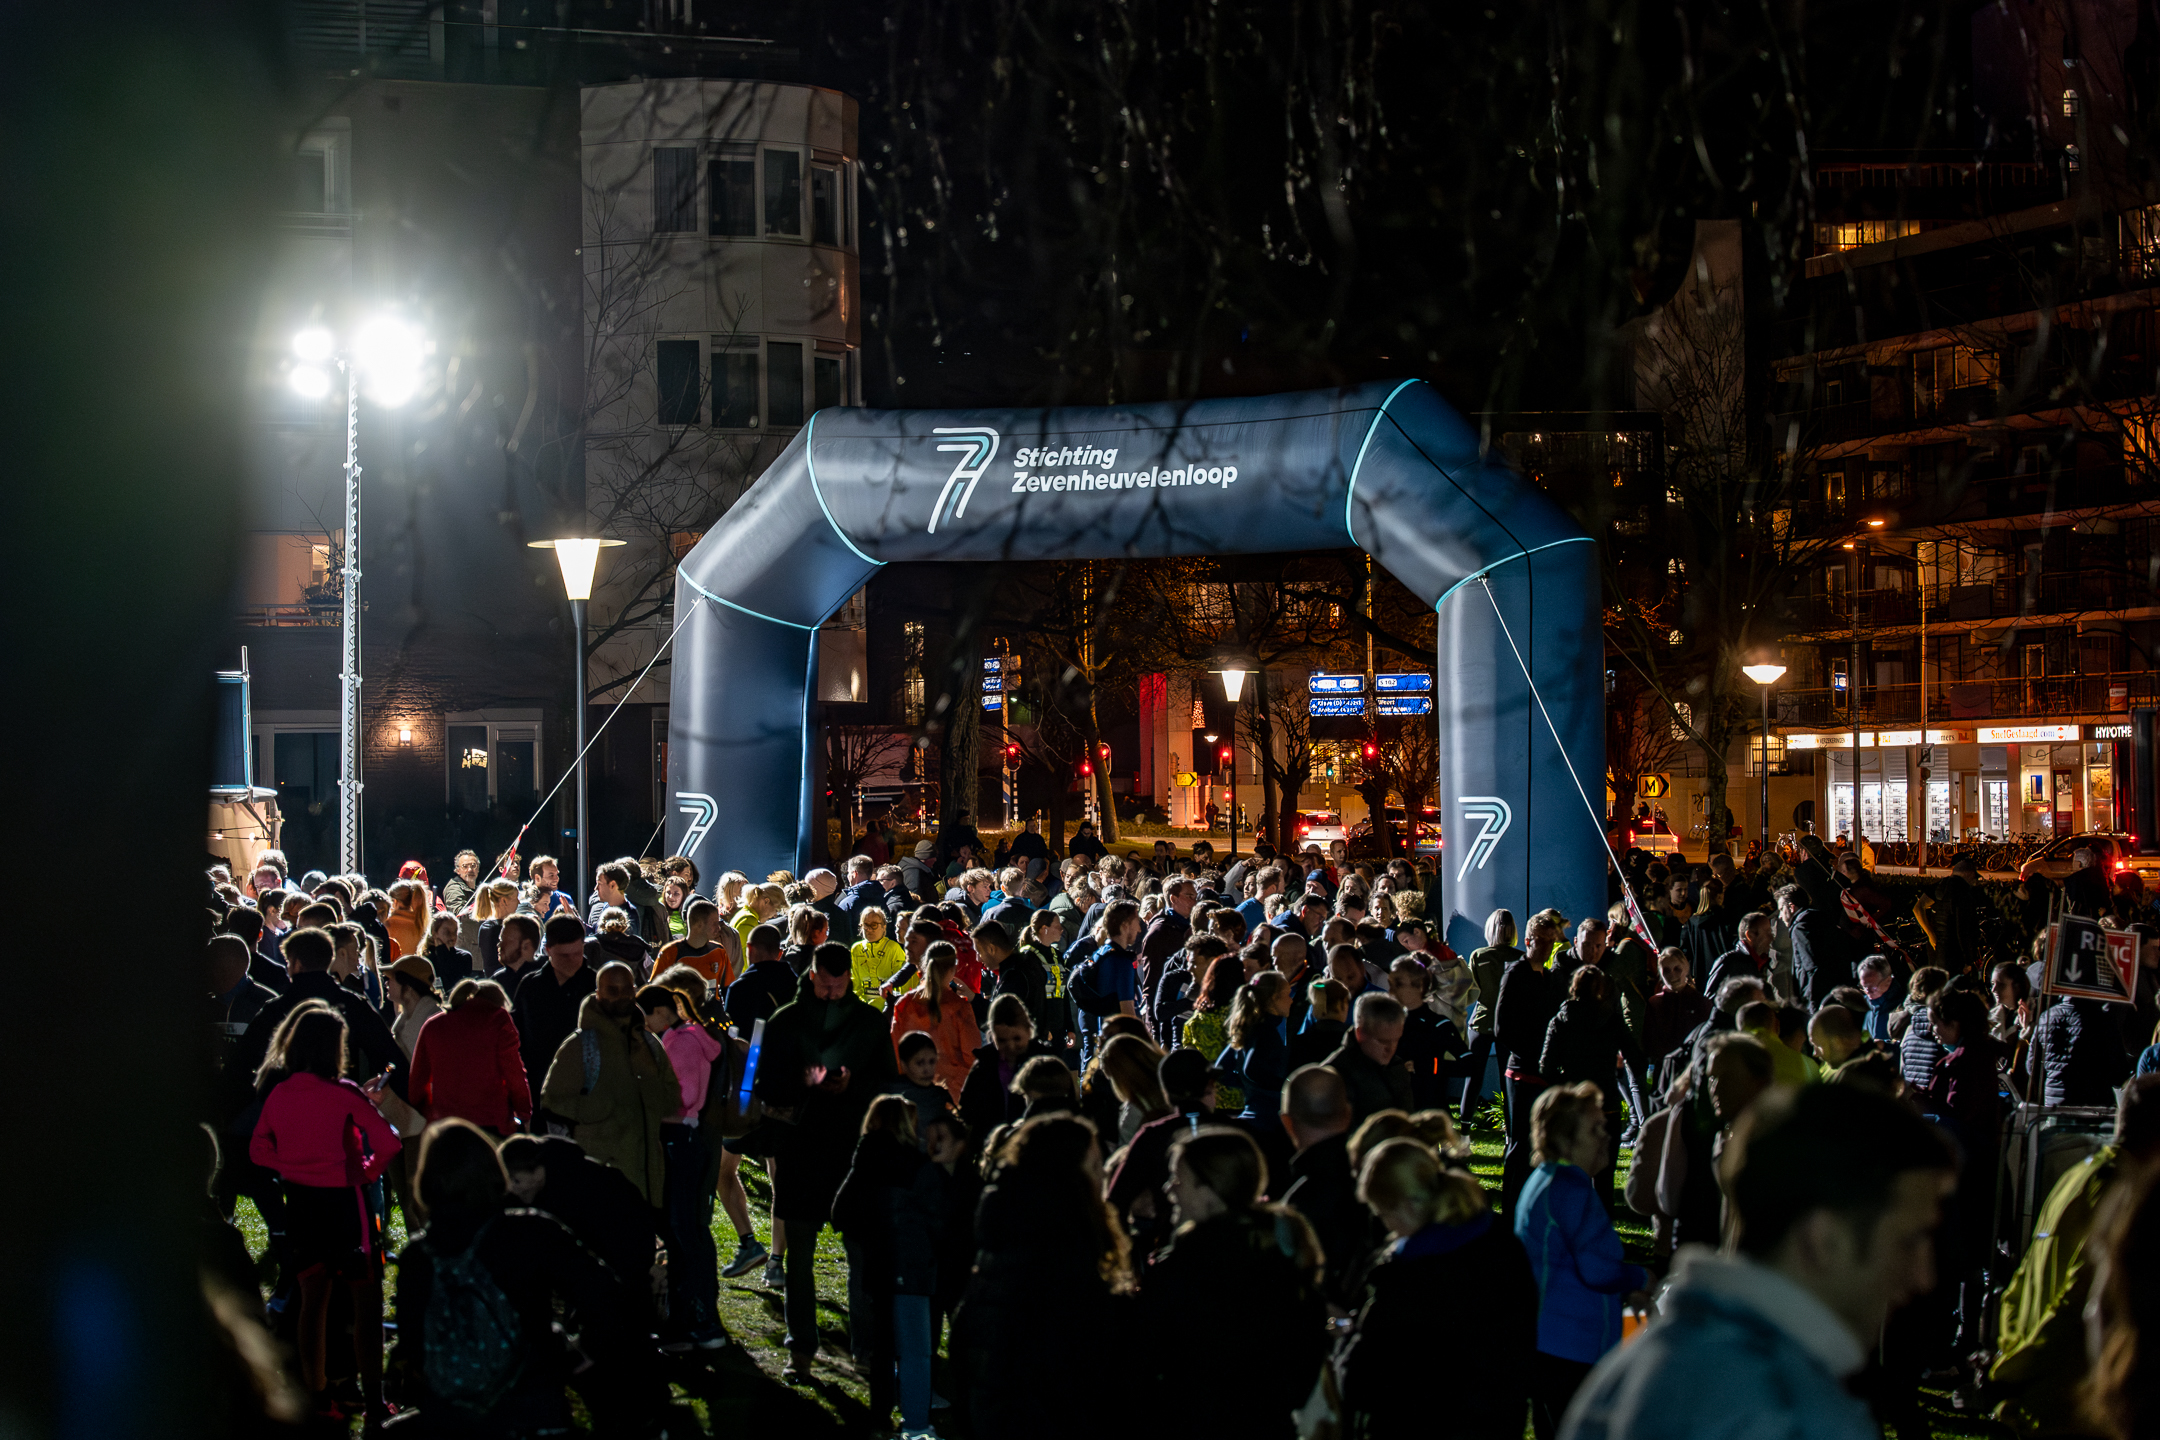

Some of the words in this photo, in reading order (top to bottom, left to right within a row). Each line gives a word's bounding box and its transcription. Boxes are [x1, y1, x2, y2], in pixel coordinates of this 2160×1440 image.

[1013, 443, 1119, 470] Stichting
[1011, 464, 1239, 493] Zevenheuvelenloop
[1645, 779, 1656, 793] M
